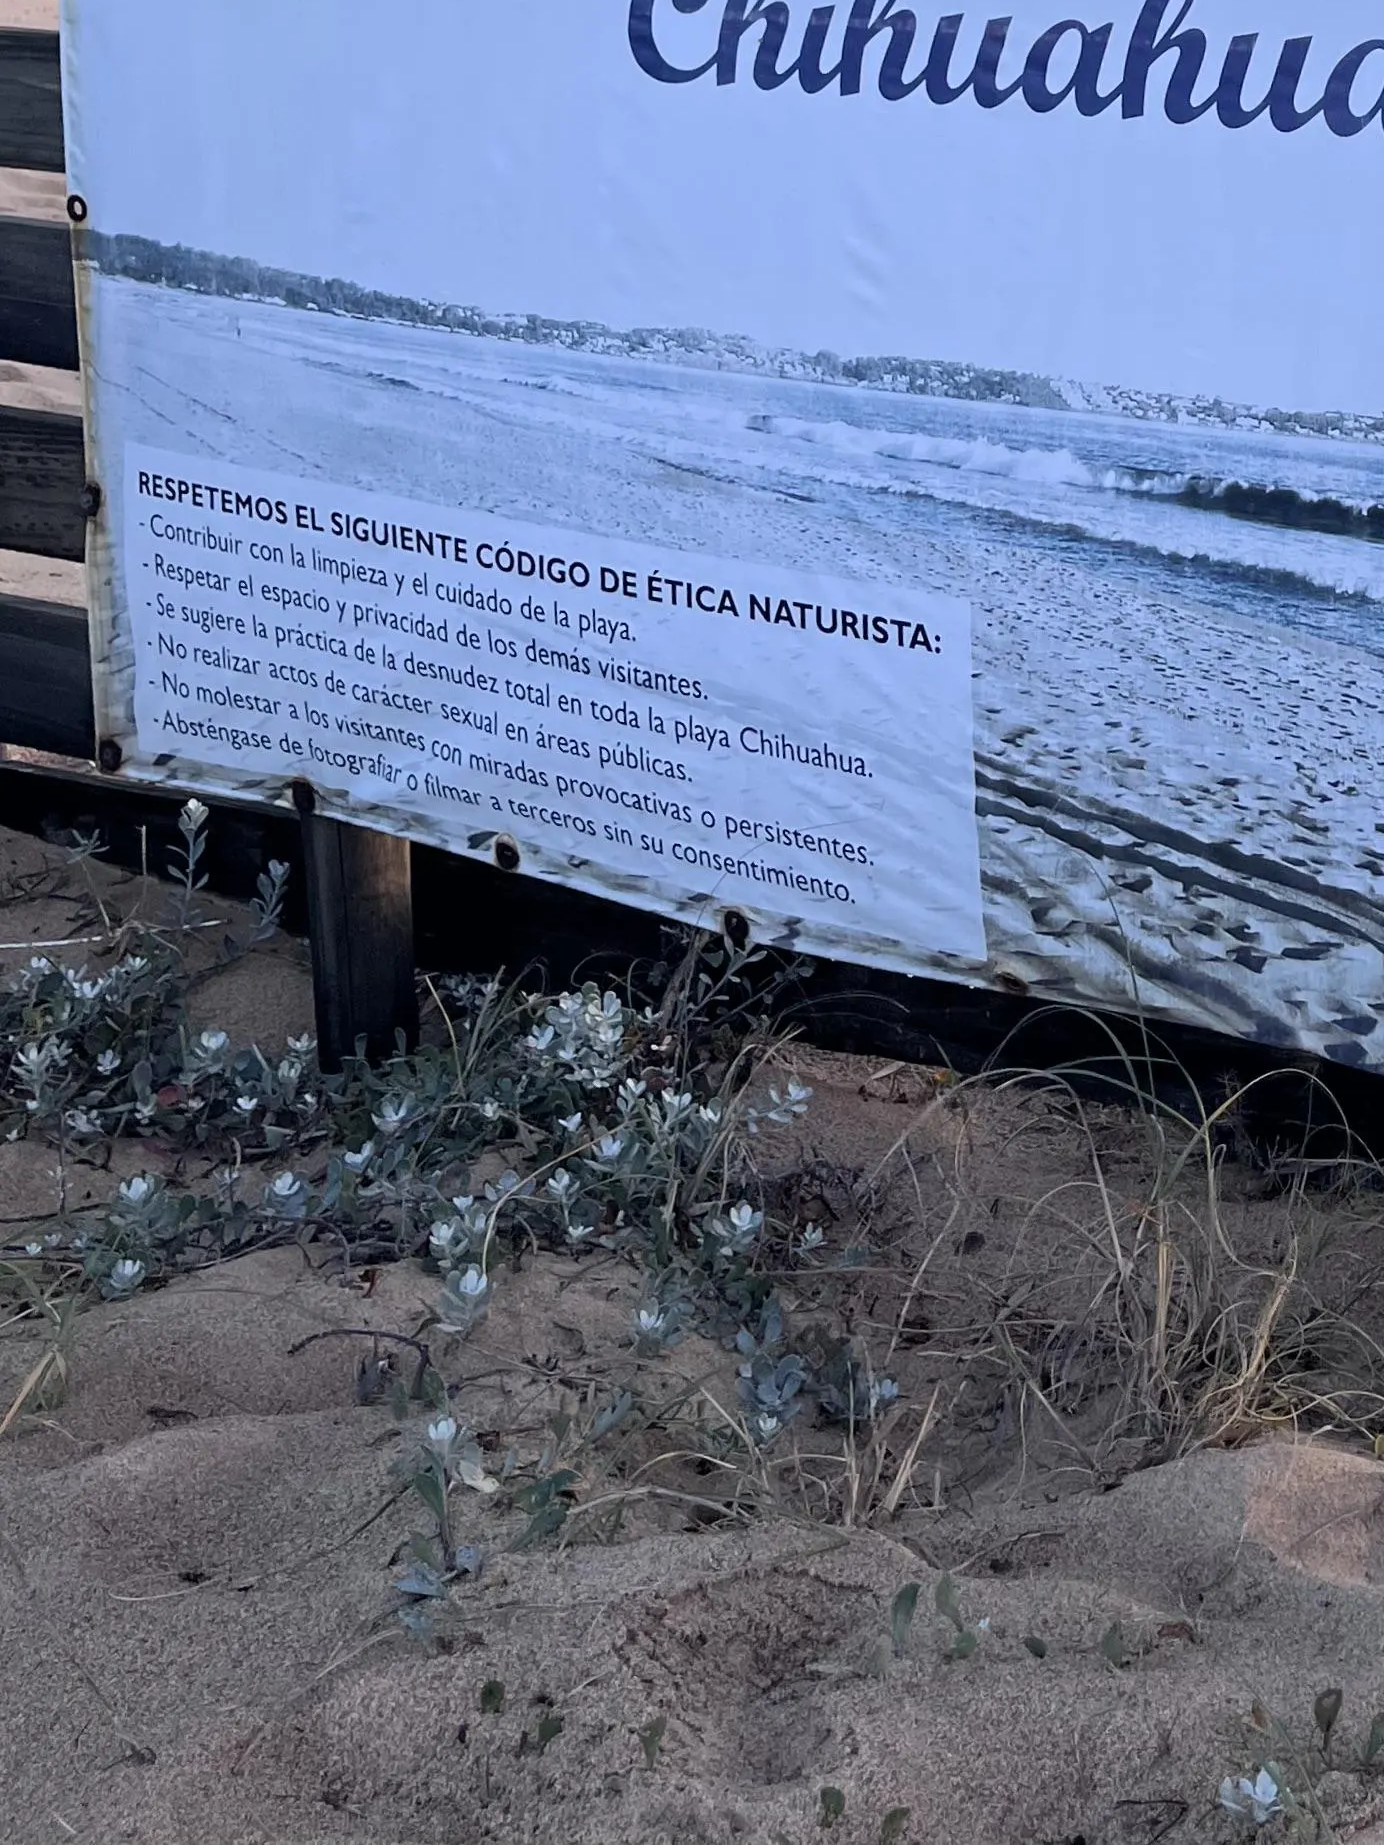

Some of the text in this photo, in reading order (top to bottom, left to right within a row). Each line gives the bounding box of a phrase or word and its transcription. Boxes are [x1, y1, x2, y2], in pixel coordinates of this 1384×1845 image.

[138, 470, 942, 655] RESPETEMOS EL SIGUIENTE CÓDIGO DE ÉTICA NATURISTA:
[149, 513, 244, 556] Contribuir
[249, 542, 285, 565] con
[289, 542, 307, 569] la
[311, 547, 389, 588] limpieza
[393, 572, 406, 597] y
[411, 571, 429, 597] el
[435, 581, 513, 616] cuidado
[519, 594, 547, 623] de
[553, 600, 571, 629] la
[578, 607, 637, 645] playa.
[154, 552, 232, 592] Respetar
[237, 573, 254, 598] el
[260, 584, 330, 614] espacio
[335, 599, 347, 624] y
[353, 602, 449, 644] privacidad
[455, 622, 482, 651] de
[487, 628, 518, 659] los
[524, 637, 592, 676] demás
[597, 656, 709, 701] visitantes.
[156, 592, 176, 620] Se
[180, 605, 246, 635] sugiere
[252, 613, 269, 640] la
[274, 622, 349, 658] práctica
[353, 637, 376, 665] de
[382, 643, 398, 671] la
[403, 650, 500, 695] desnudez
[504, 678, 551, 709] total
[557, 694, 583, 717] en
[589, 700, 641, 730] toda
[648, 705, 667, 735] la
[674, 714, 732, 752] playa
[739, 726, 873, 779] Chihuahua.
[158, 631, 188, 660] No
[193, 645, 262, 676] realizar
[268, 662, 319, 688] actos
[324, 669, 347, 696] de
[351, 683, 434, 715] carácter
[440, 702, 498, 737] sexual
[504, 722, 529, 745] en
[535, 722, 591, 759] áreas
[598, 741, 693, 784] públicas.
[161, 670, 190, 699] No
[196, 685, 282, 716] molestar
[288, 703, 300, 721] a
[303, 700, 330, 730] los
[334, 714, 426, 752] visitantes
[431, 739, 462, 767] con
[469, 752, 550, 788] miradas
[555, 775, 693, 824] provocativas
[700, 810, 716, 829] o
[724, 815, 875, 867] persistentes.
[161, 709, 273, 751] Absténgase
[278, 732, 304, 756] de
[307, 738, 403, 784] fotografiar
[406, 773, 419, 792] o
[423, 772, 482, 807] filmar
[489, 795, 504, 812] a
[507, 798, 597, 837] terceros
[603, 820, 634, 847] sin
[640, 833, 664, 856] su
[671, 842, 856, 904] consentimiento.
